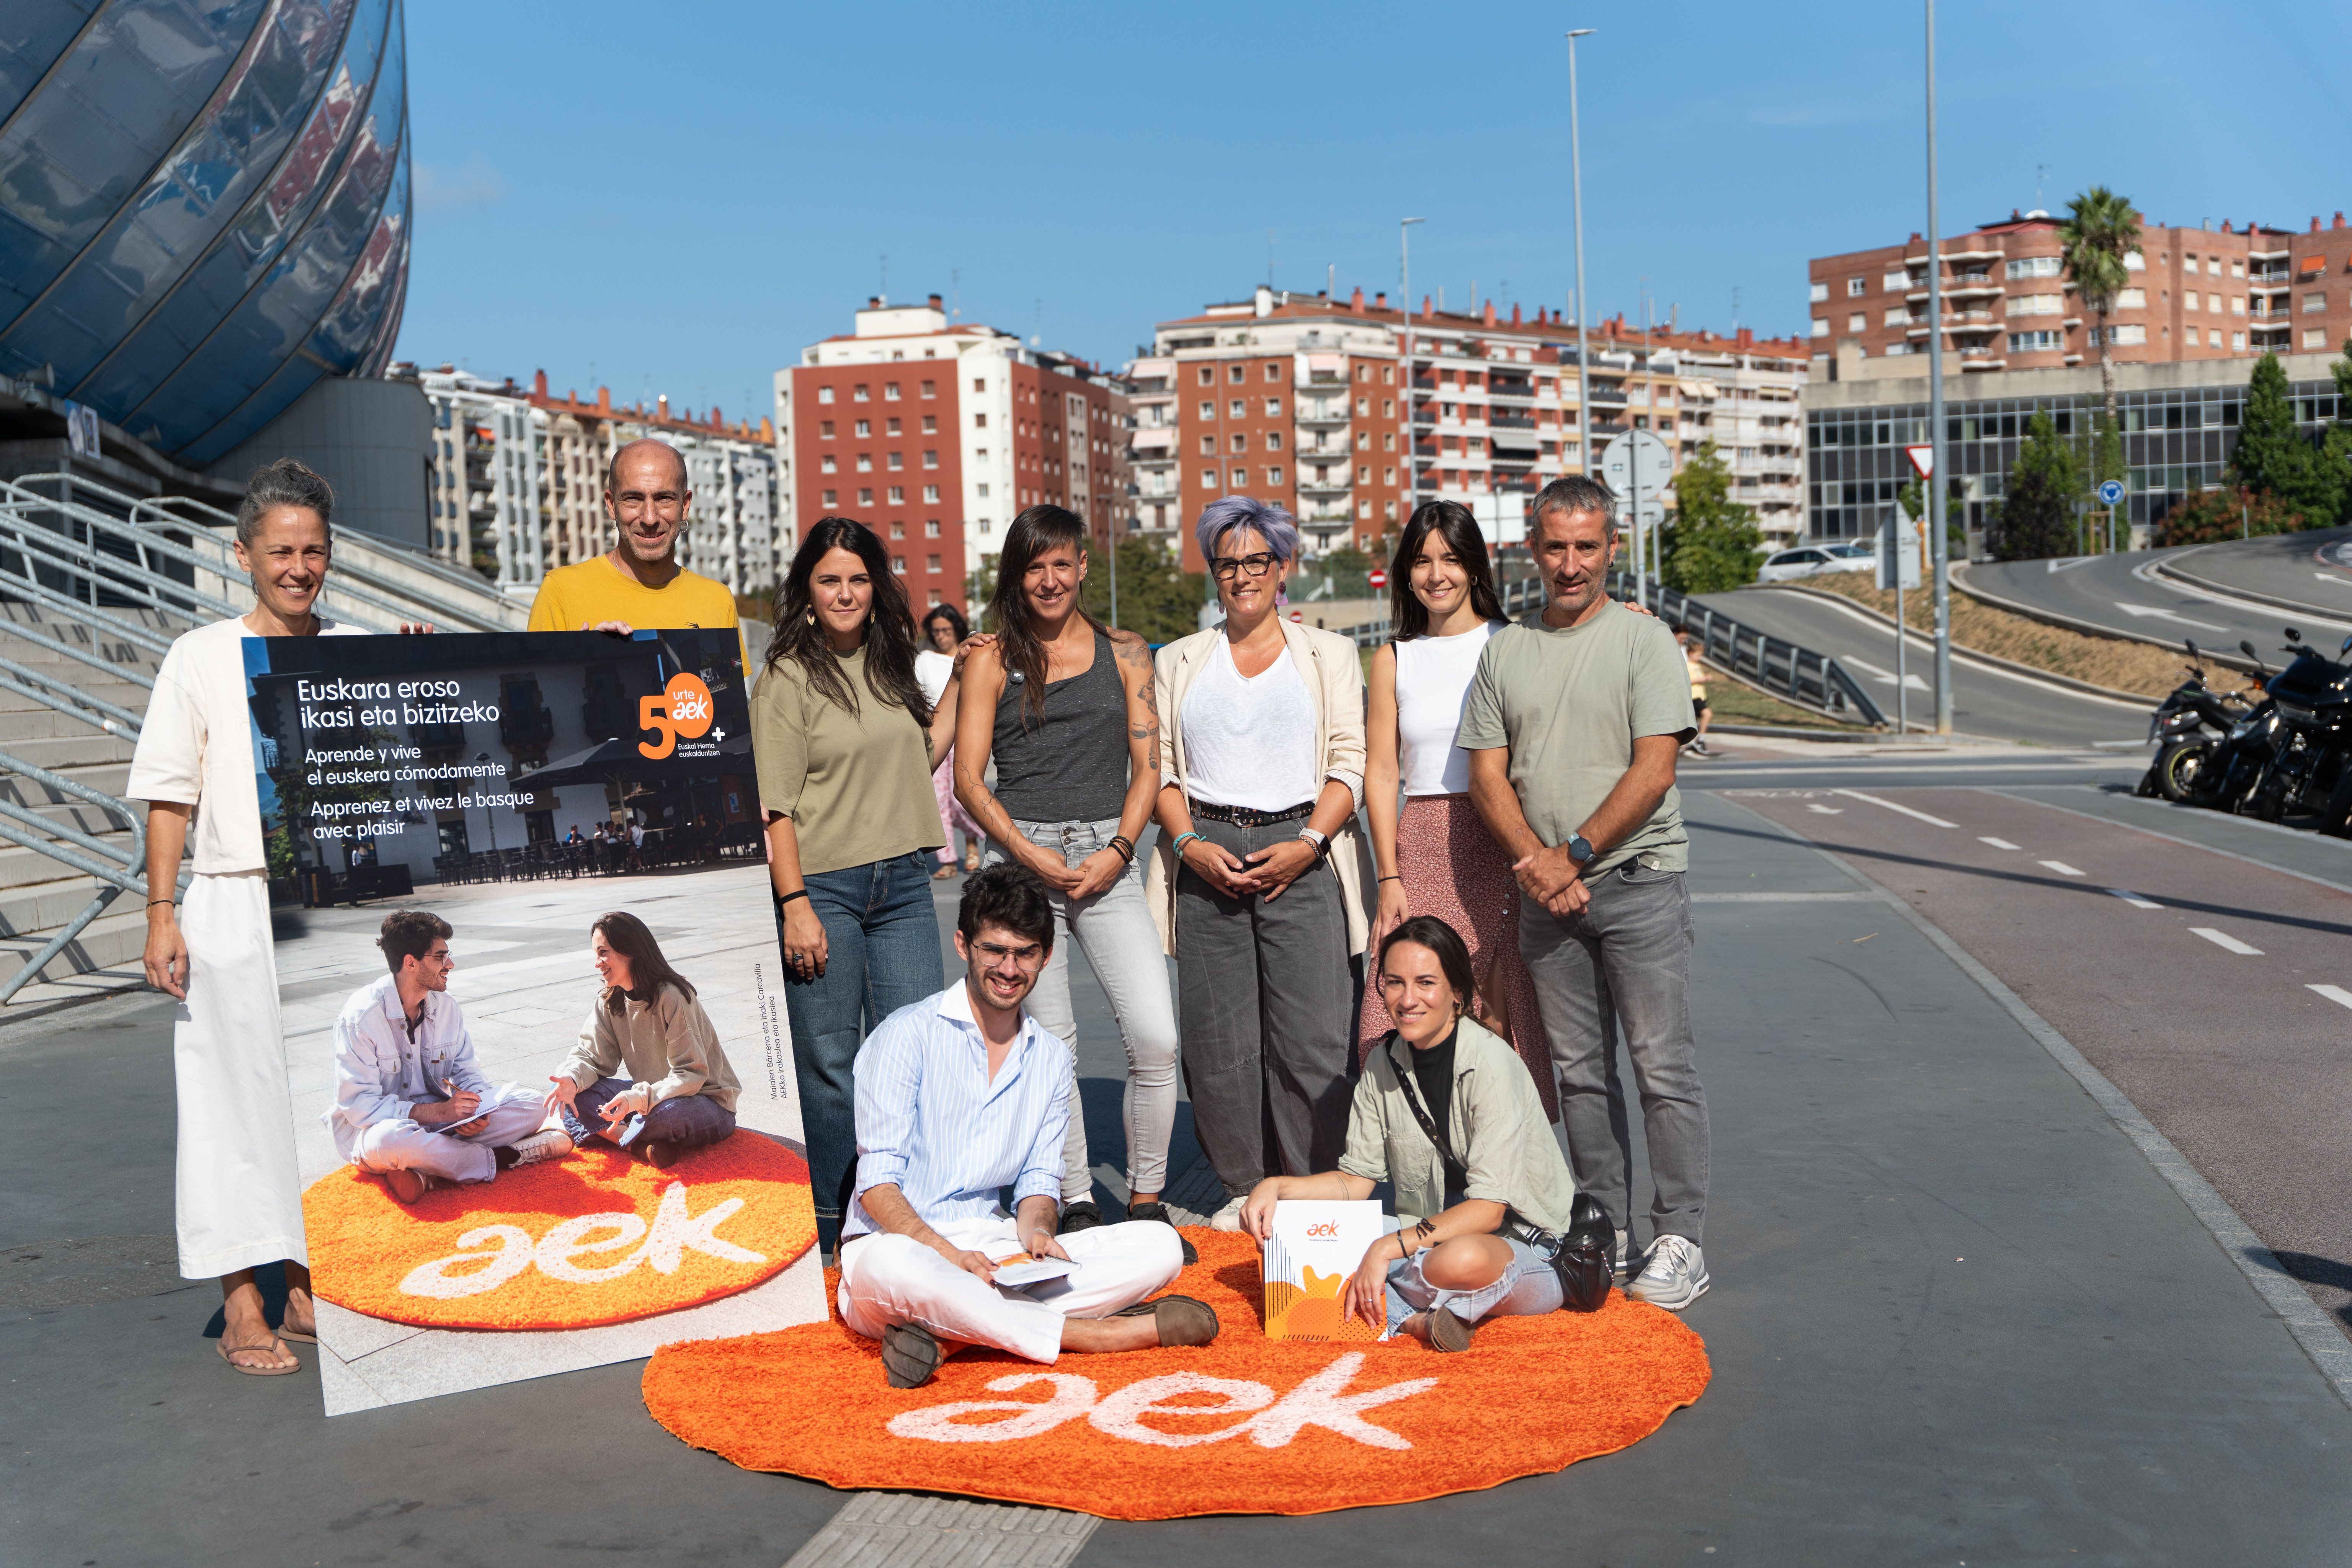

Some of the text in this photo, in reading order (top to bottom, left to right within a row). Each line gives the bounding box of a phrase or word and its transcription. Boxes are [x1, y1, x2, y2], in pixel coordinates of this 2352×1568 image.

[297, 678, 459, 701] Euskara eroso
[673, 689, 695, 700] urte
[301, 700, 499, 728] ikasi eta bizitzeko
[672, 694, 708, 720] aek
[305, 745, 421, 766] Aprende y vive
[307, 763, 505, 785] el euskera cómodamente
[311, 791, 534, 820] Apprenez et vivez le basque
[313, 819, 405, 840] avec plaisir
[754, 964, 764, 1000] Carcavilla
[769, 994, 777, 1022] ikaslea.
[765, 1036, 773, 1067] Bárcena
[774, 1039, 784, 1073] irakaslea
[769, 1070, 777, 1100] Maialen
[779, 1075, 787, 1099] AEKko
[398, 1181, 767, 1299] aek
[1307, 1218, 1339, 1236] aek
[886, 1351, 1439, 1450] aek
